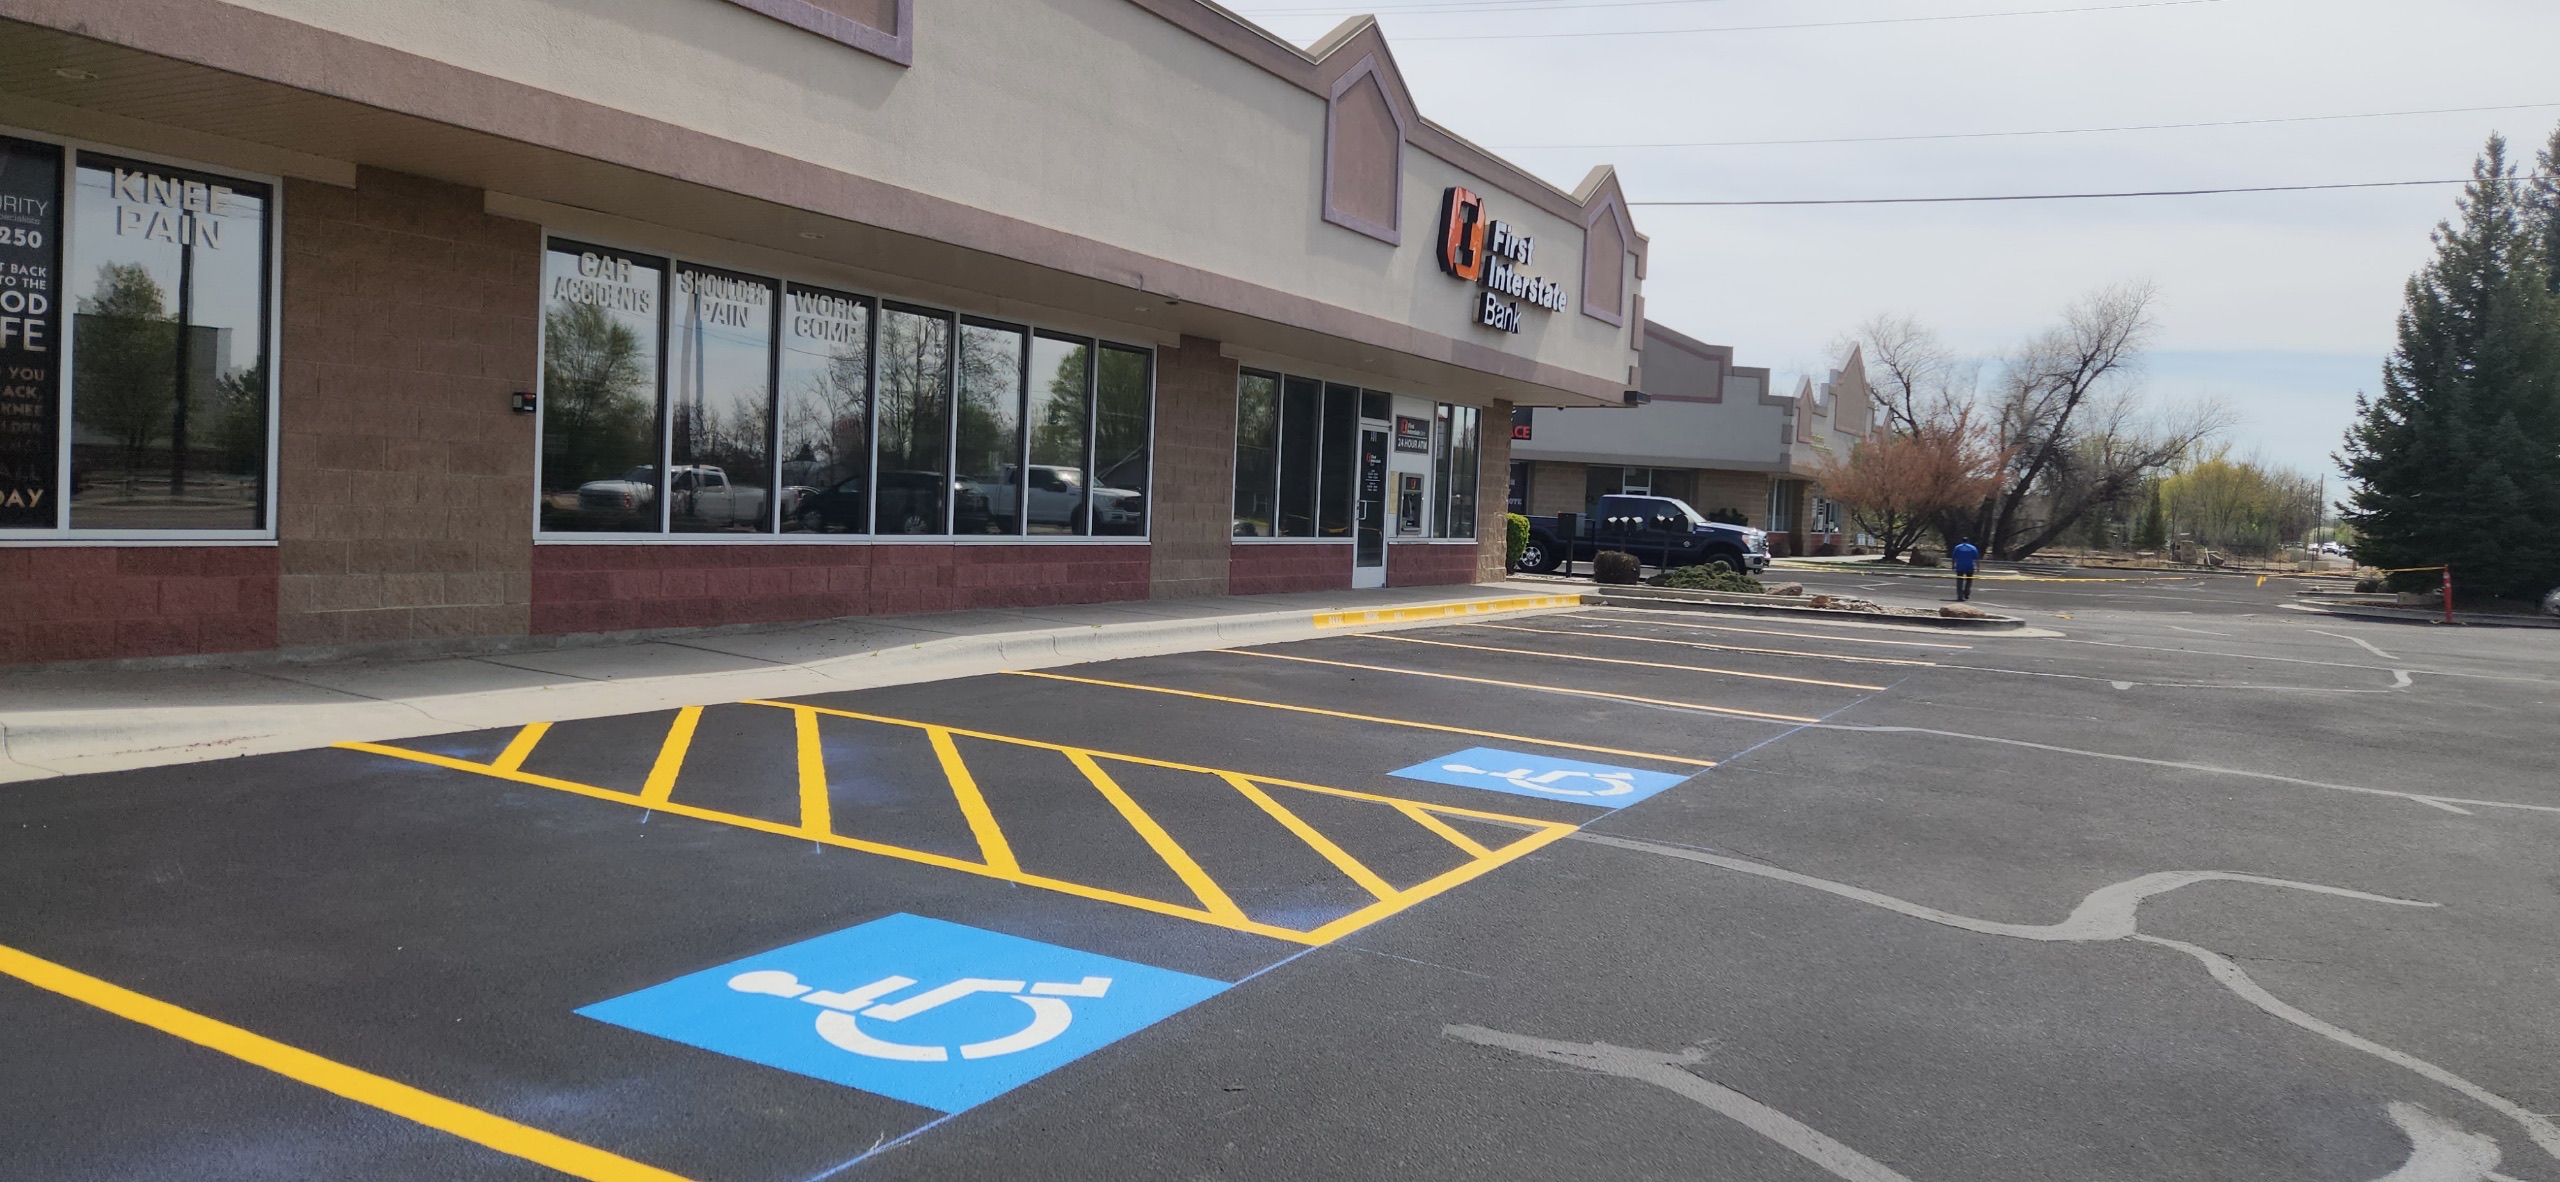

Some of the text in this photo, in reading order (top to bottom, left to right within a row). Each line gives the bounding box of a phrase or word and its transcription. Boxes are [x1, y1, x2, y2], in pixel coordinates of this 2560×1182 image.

[0, 194, 49, 217] RITY
[113, 168, 233, 217] KNEE
[0, 226, 43, 249] 250
[118, 206, 223, 249] PAIN
[1491, 220, 1536, 266] First
[11, 263, 47, 278] BACK
[579, 251, 633, 283] CAR
[22, 277, 47, 291] THE
[553, 276, 651, 313] ACCIDENTS
[681, 270, 767, 305] SHOULDER
[1488, 256, 1568, 314] Interstate
[701, 301, 749, 328] PAIN
[795, 290, 861, 321] WORK
[1483, 292, 1522, 335] Bank
[0, 316, 47, 352] FE
[795, 315, 859, 344] COMP
[8, 365, 45, 382] YOU
[1404, 438, 1418, 449] HOUR
